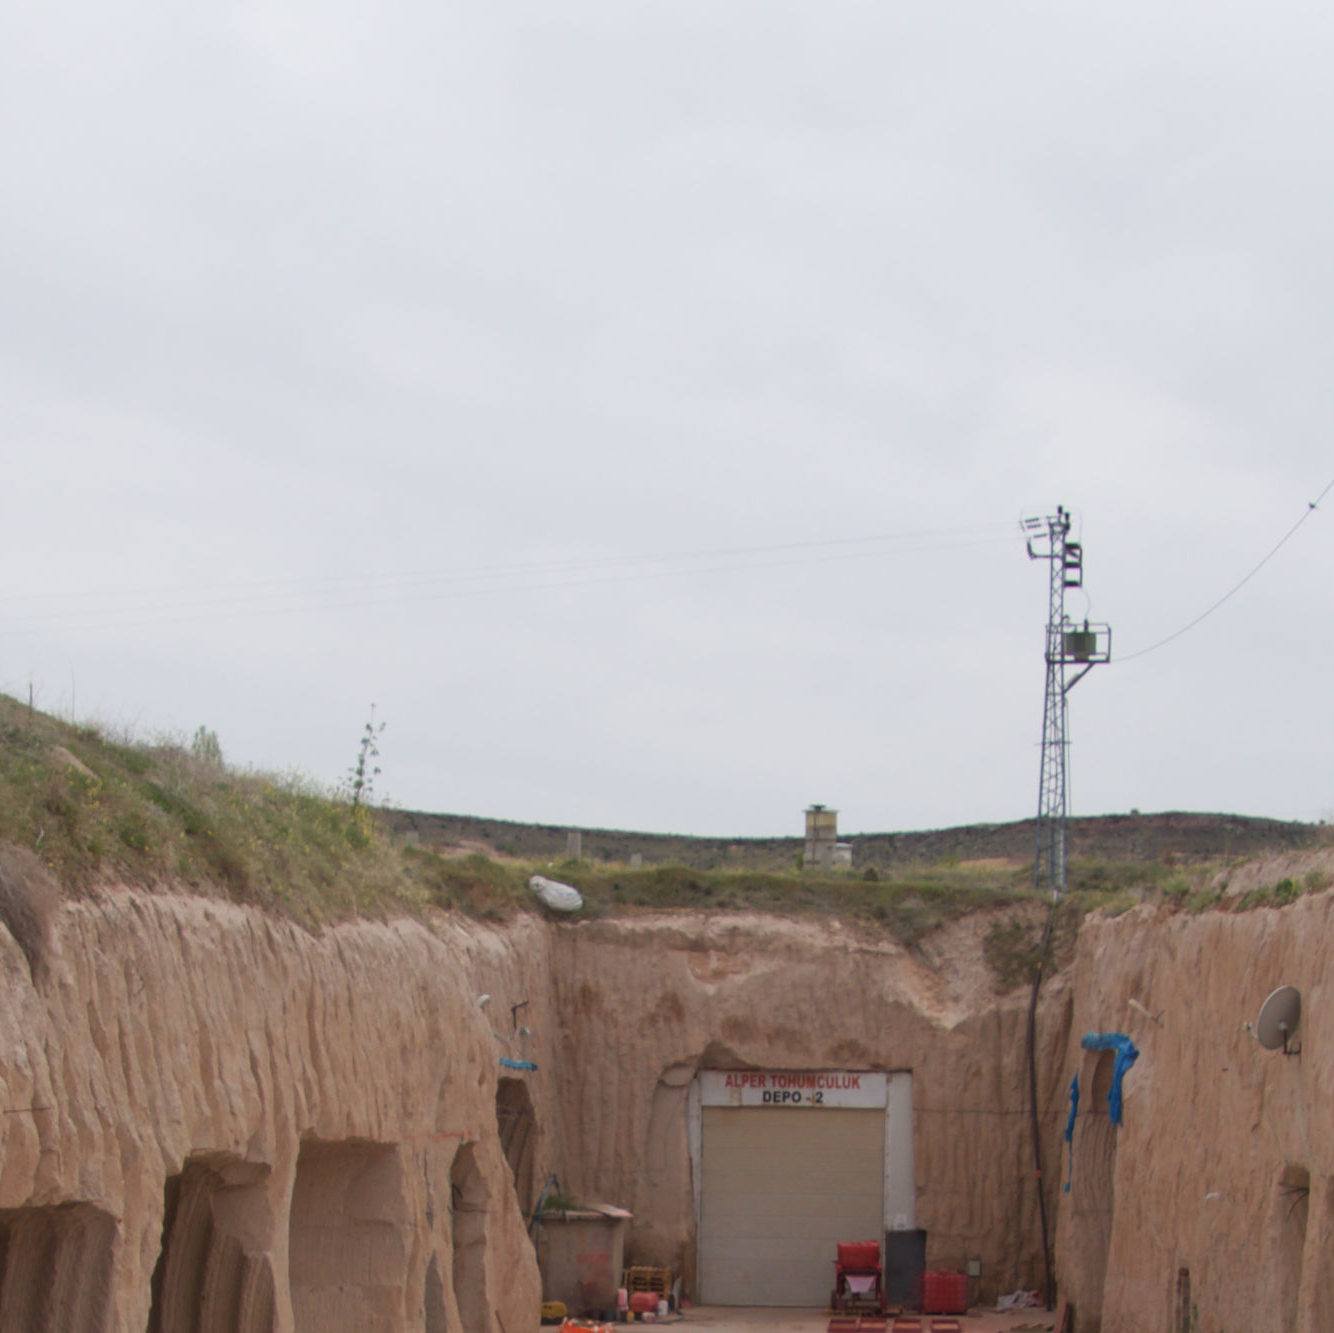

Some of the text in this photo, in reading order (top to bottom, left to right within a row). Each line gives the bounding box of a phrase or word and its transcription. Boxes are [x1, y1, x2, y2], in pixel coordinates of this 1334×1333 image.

[725, 1074, 861, 1089] ALPER TOHUMCULUK
[762, 1090, 802, 1103] DEPO
[815, 1091, 824, 1103] 2
